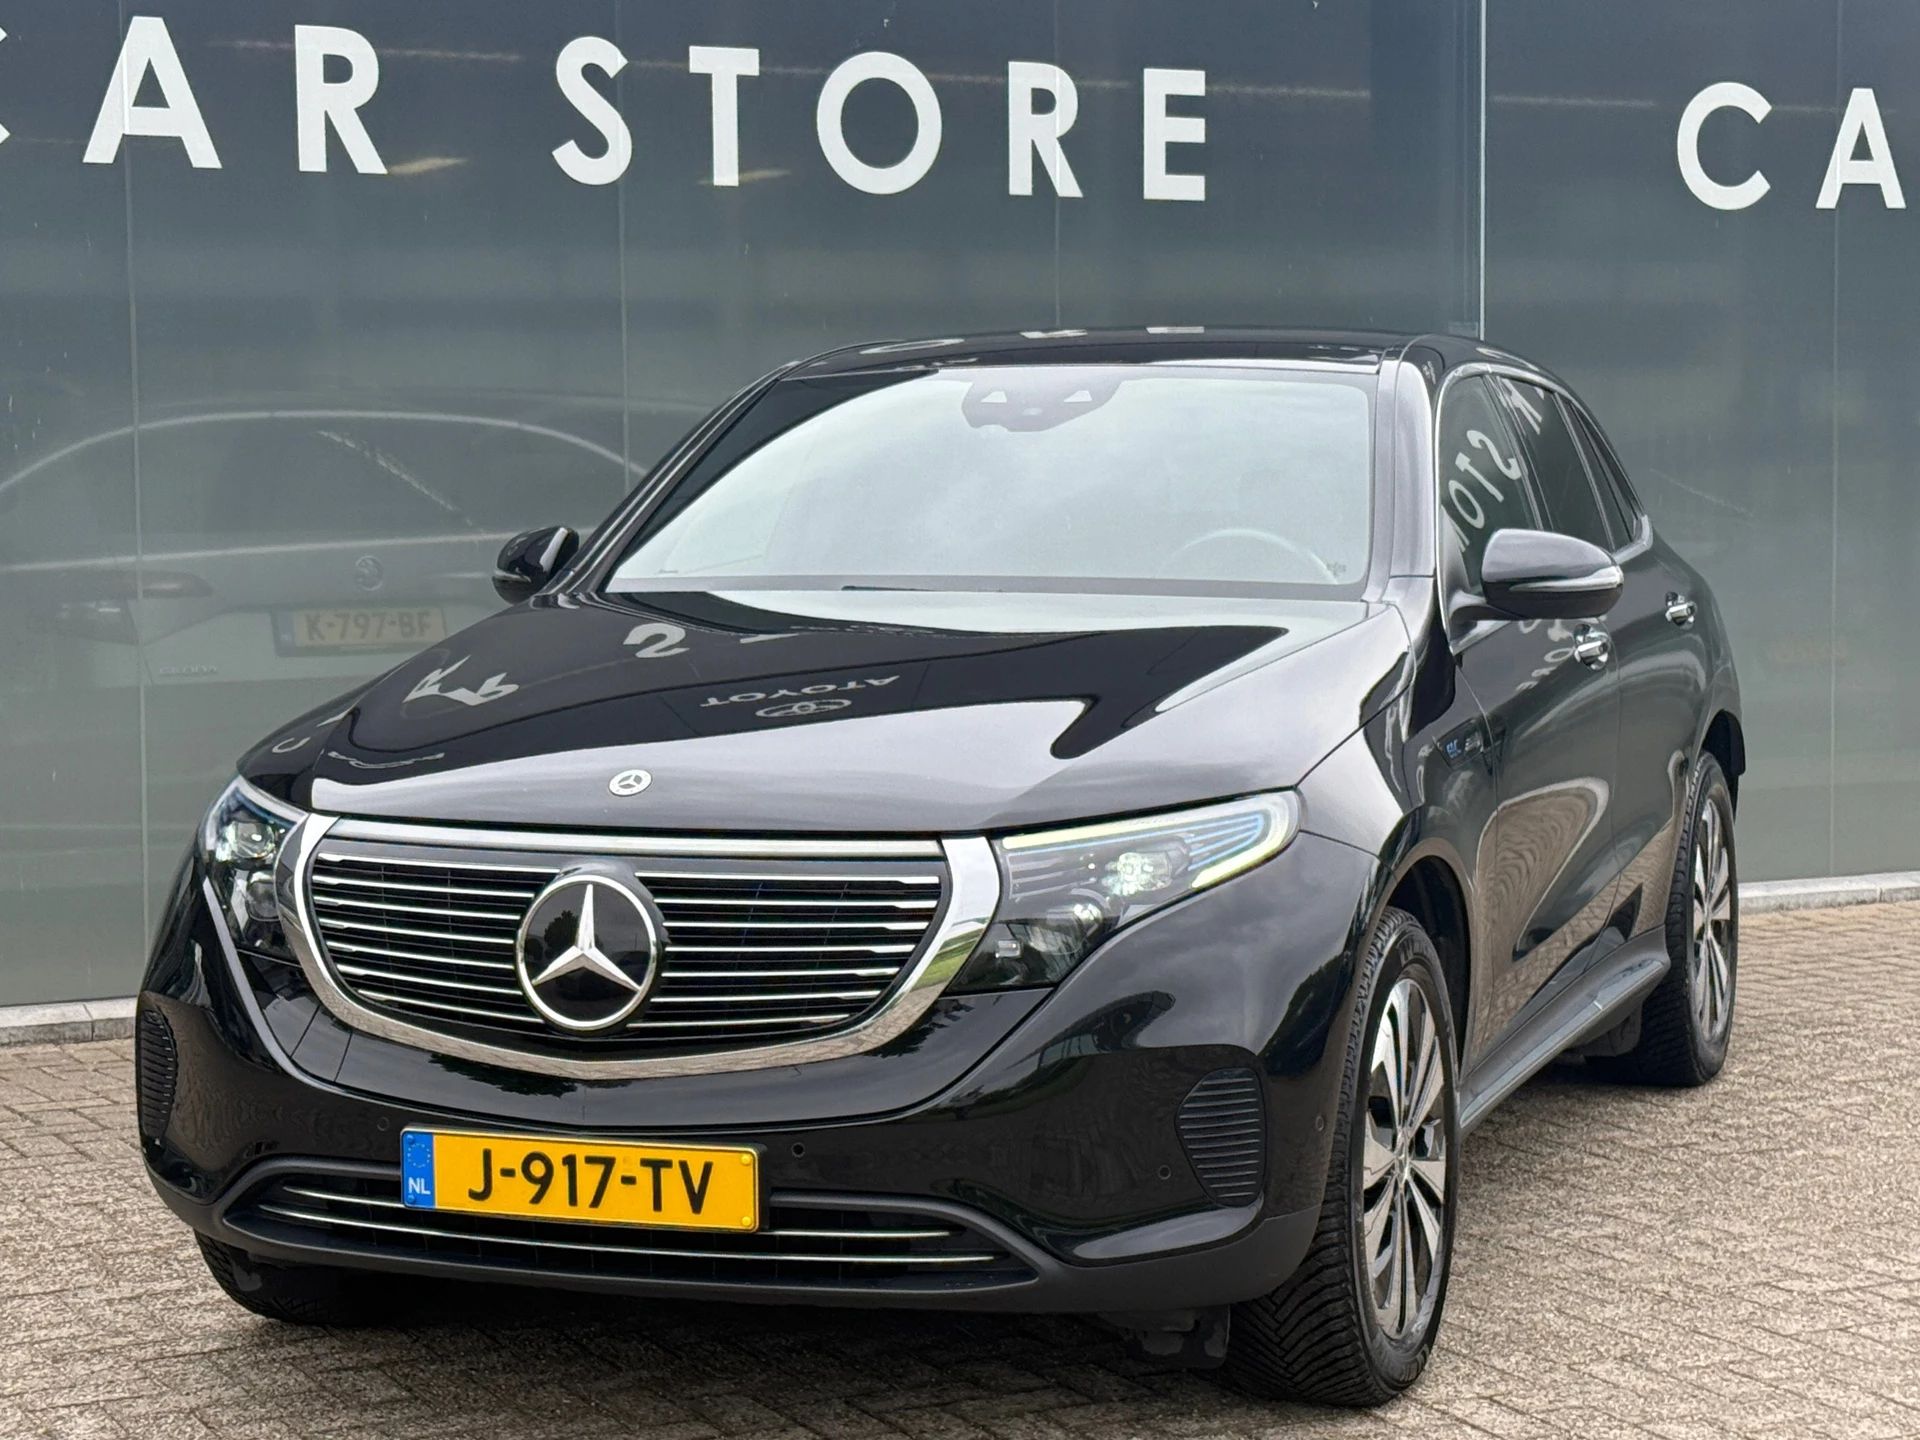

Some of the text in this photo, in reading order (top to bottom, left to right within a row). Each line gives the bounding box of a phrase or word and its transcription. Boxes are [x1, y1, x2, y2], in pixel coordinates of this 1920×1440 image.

[0, 15, 1206, 201] AR STORE
[1677, 82, 1907, 211] CA
[305, 610, 431, 642] K-797-BF
[408, 1176, 431, 1195] NL
[468, 1148, 713, 1215] J-917-TV
